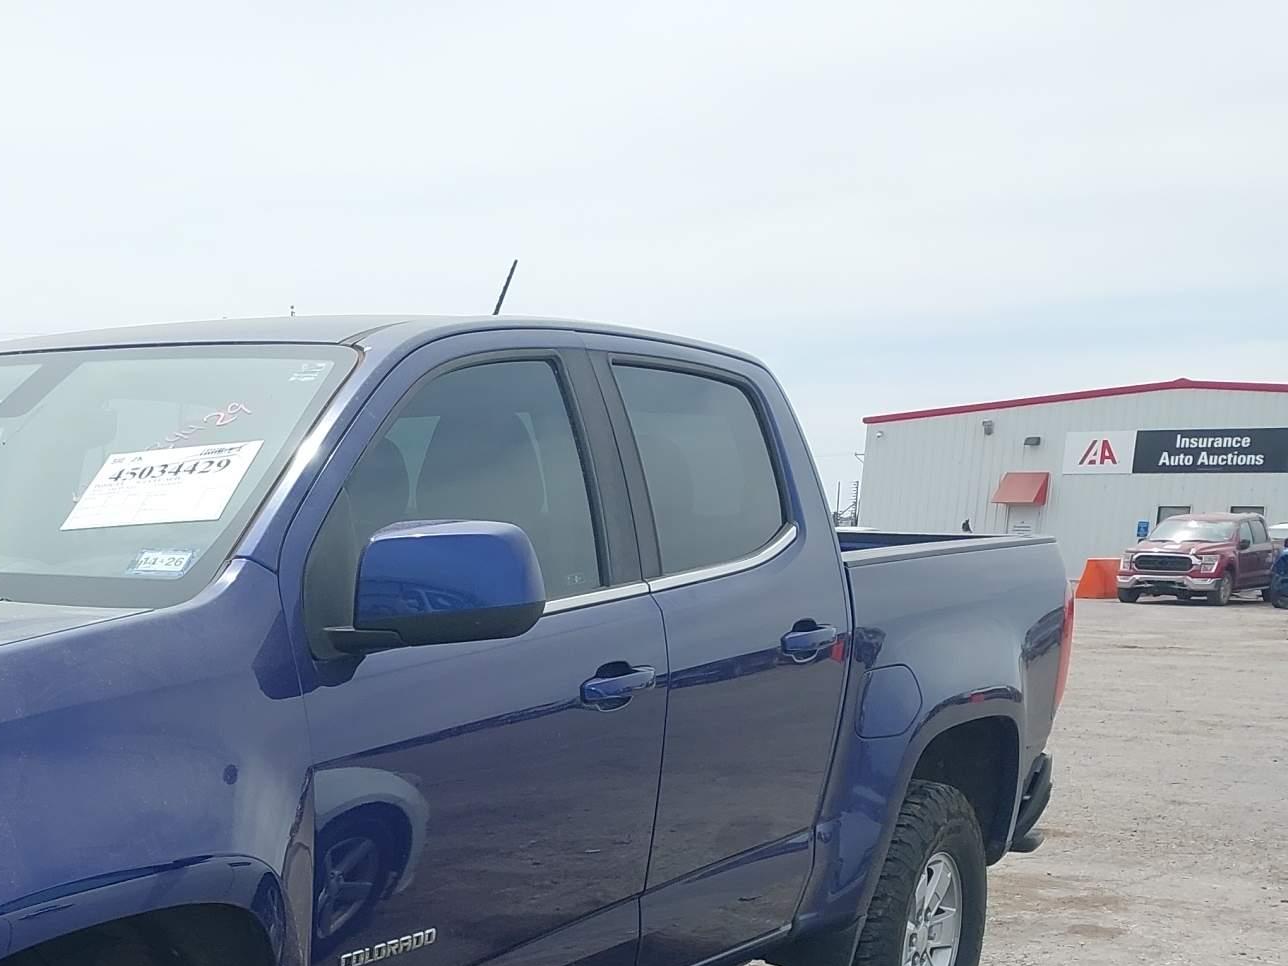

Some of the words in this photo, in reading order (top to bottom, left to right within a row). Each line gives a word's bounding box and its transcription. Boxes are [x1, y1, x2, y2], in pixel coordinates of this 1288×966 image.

[1175, 434, 1251, 448] Insurance
[1158, 451, 1193, 466] Auto
[1197, 451, 1264, 466] Auctions
[109, 458, 231, 482] 45034429
